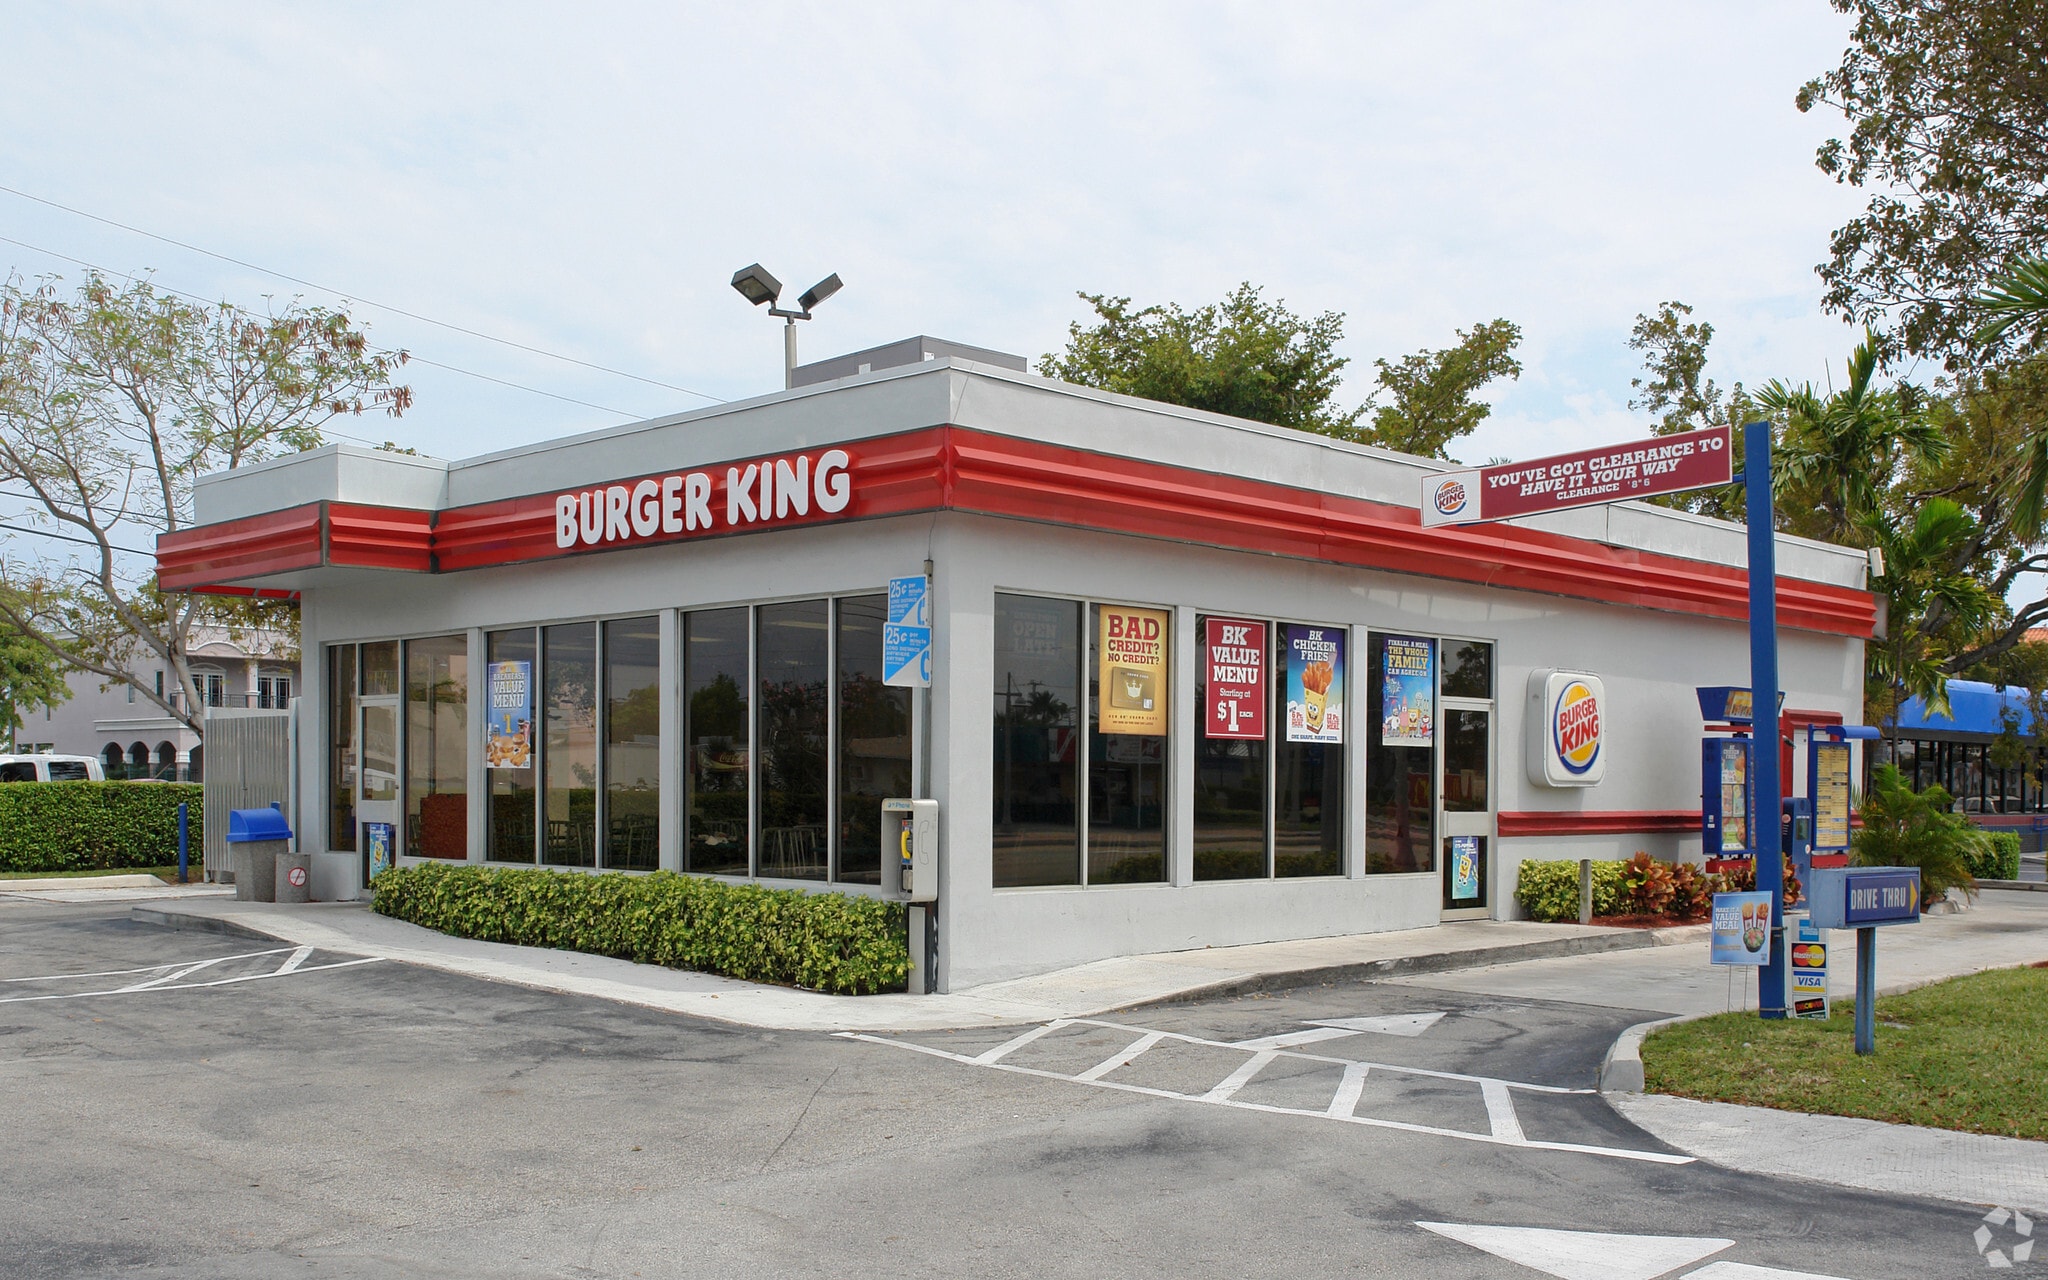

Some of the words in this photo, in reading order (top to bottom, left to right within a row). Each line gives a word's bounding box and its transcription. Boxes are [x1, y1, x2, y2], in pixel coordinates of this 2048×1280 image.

[1488, 466, 1546, 489] YOU'VE
[1550, 460, 1585, 478] GOT
[1588, 441, 1695, 471] CLEARANCE
[1698, 436, 1724, 453] TO
[1519, 475, 1565, 497] HAVE
[1568, 473, 1586, 489] IT
[1590, 465, 1638, 485] YOUR
[1641, 458, 1682, 477] WAY
[555, 472, 713, 549] BURGER
[726, 449, 851, 526] KING
[1437, 484, 1464, 501] BURGER
[1438, 491, 1466, 509] KING
[1556, 482, 1620, 501] CLEARANCE
[1107, 614, 1160, 641] BAD
[1221, 625, 1250, 646] BK
[1308, 630, 1324, 641] BK
[1107, 639, 1160, 656] CREDIT?
[1293, 639, 1336, 652] CHICKEN
[1388, 646, 1403, 655] THE
[1404, 647, 1429, 657] WHOLE
[1107, 653, 1120, 662] NO
[1122, 654, 1160, 665] CREDIT?
[1211, 645, 1260, 666] VALUE
[1301, 650, 1329, 662] FRIES
[1388, 655, 1428, 669] FAMILY
[493, 672, 526, 681] BREAKFAST
[1213, 665, 1259, 685] MENU
[493, 680, 526, 694] VALUE
[1219, 687, 1243, 699] Starting
[1244, 690, 1251, 698] at
[493, 693, 525, 708] MENU
[1217, 700, 1240, 732] $1
[1559, 697, 1598, 732] BURGER
[1560, 714, 1600, 756] KING
[1850, 888, 1878, 910] DRIVE
[1882, 886, 1906, 908] THRU
[1714, 920, 1739, 930] MEAL
[1715, 912, 1740, 921] VALUE
[1797, 976, 1821, 987] VISA
